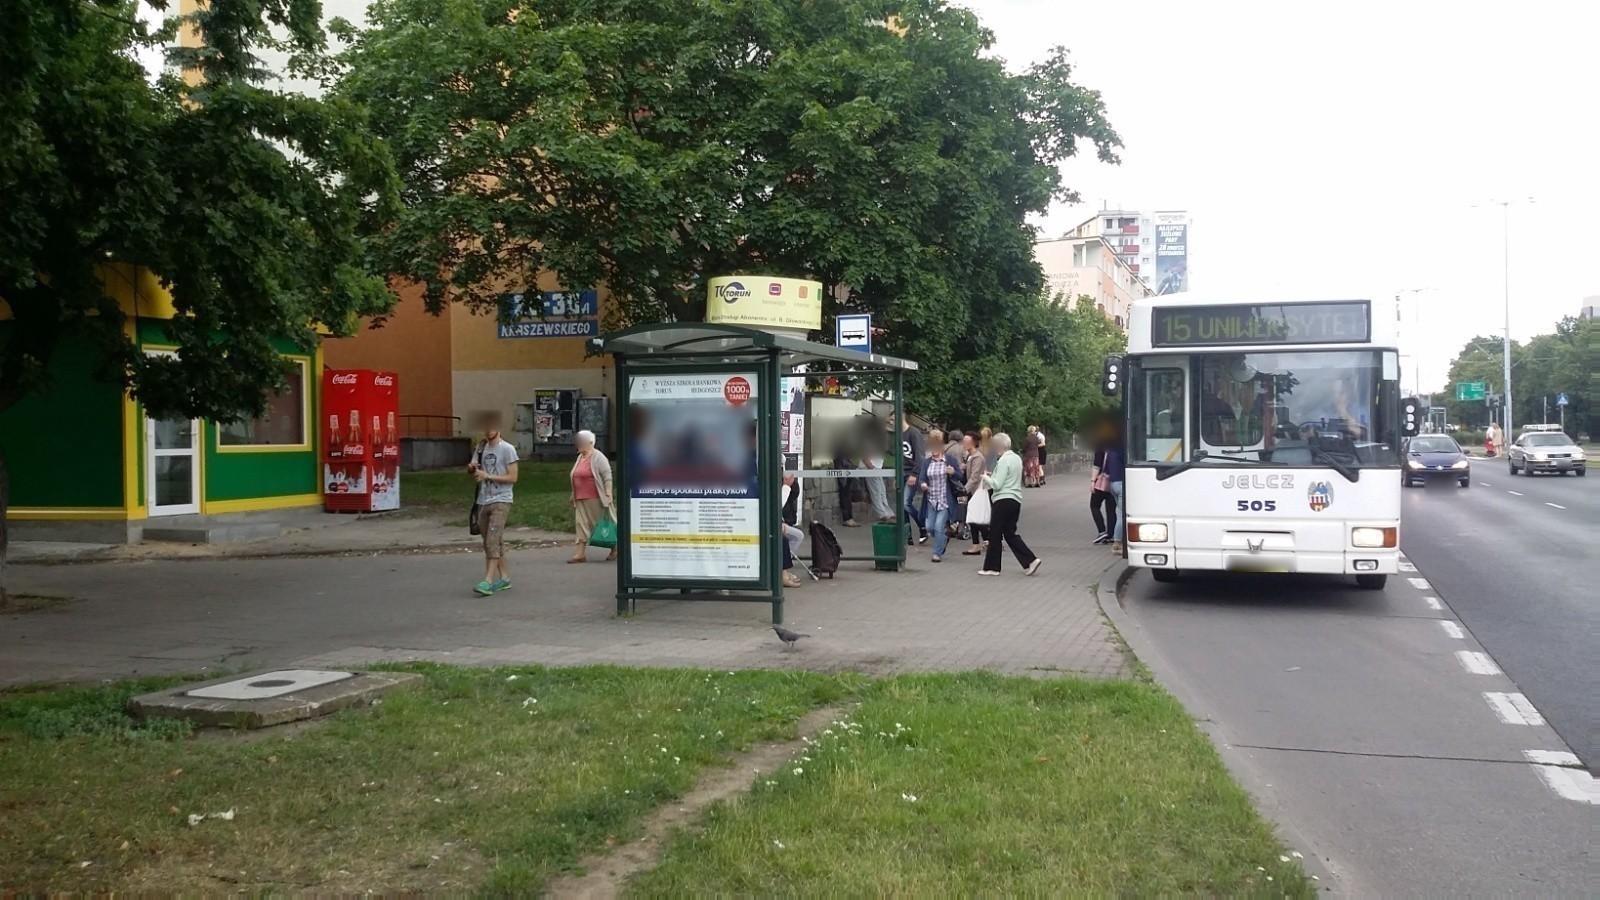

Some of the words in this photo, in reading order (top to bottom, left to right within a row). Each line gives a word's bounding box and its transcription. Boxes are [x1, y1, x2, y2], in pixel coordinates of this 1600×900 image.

[1163, 316, 1191, 341] 15
[726, 385, 745, 393] 1000
[1222, 475, 1294, 488] JELCZ
[1237, 500, 1276, 511] 505
